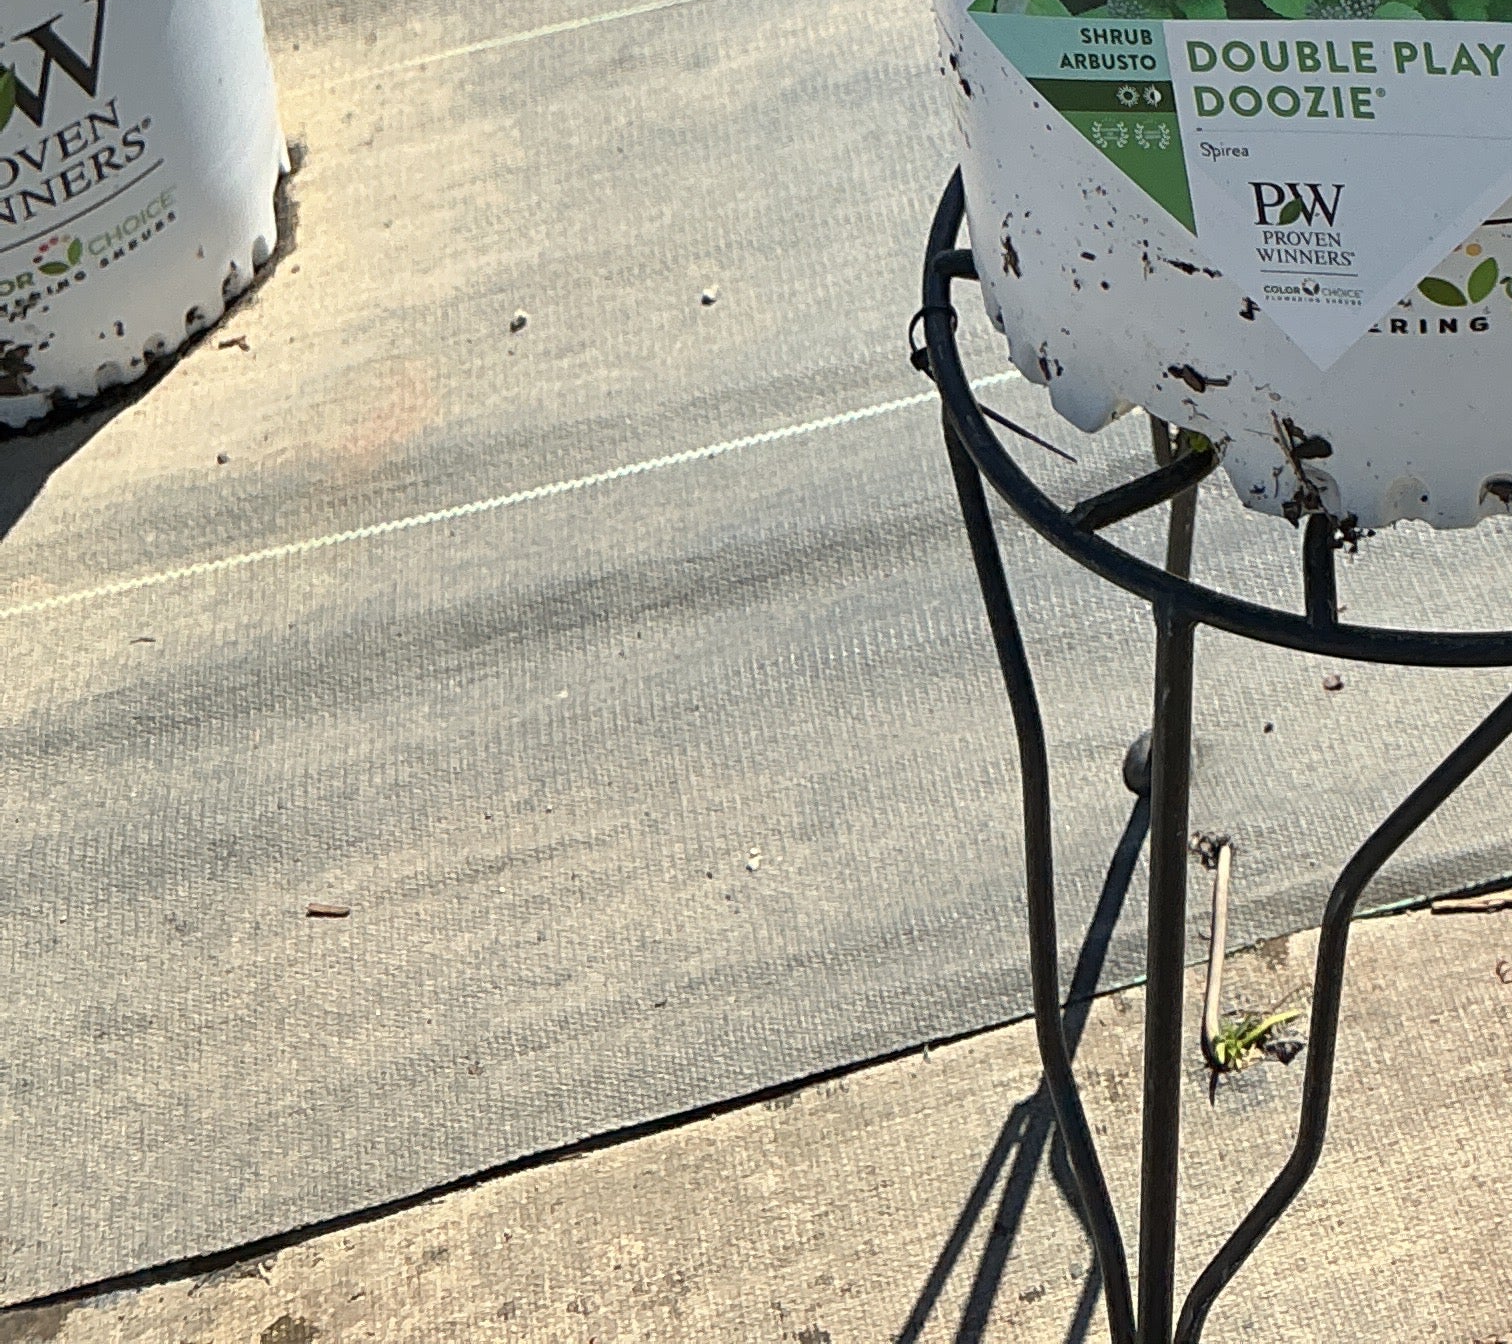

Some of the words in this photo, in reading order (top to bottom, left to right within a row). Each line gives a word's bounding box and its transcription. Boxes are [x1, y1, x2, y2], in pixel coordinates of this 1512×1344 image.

[1080, 27, 1154, 46] SHRUB
[1059, 52, 1157, 71] ARBUSTO
[1186, 40, 1378, 74] DOUBLE
[1393, 41, 1506, 77] PLAY
[1199, 141, 1250, 162] Spirea
[1248, 181, 1346, 228] PW
[87, 185, 178, 257] CHOICE
[1261, 230, 1342, 248] PROVEN
[1255, 247, 1356, 267] WINNERS
[1263, 285, 1301, 295] COLOR
[1321, 289, 1363, 299] CHOICE
